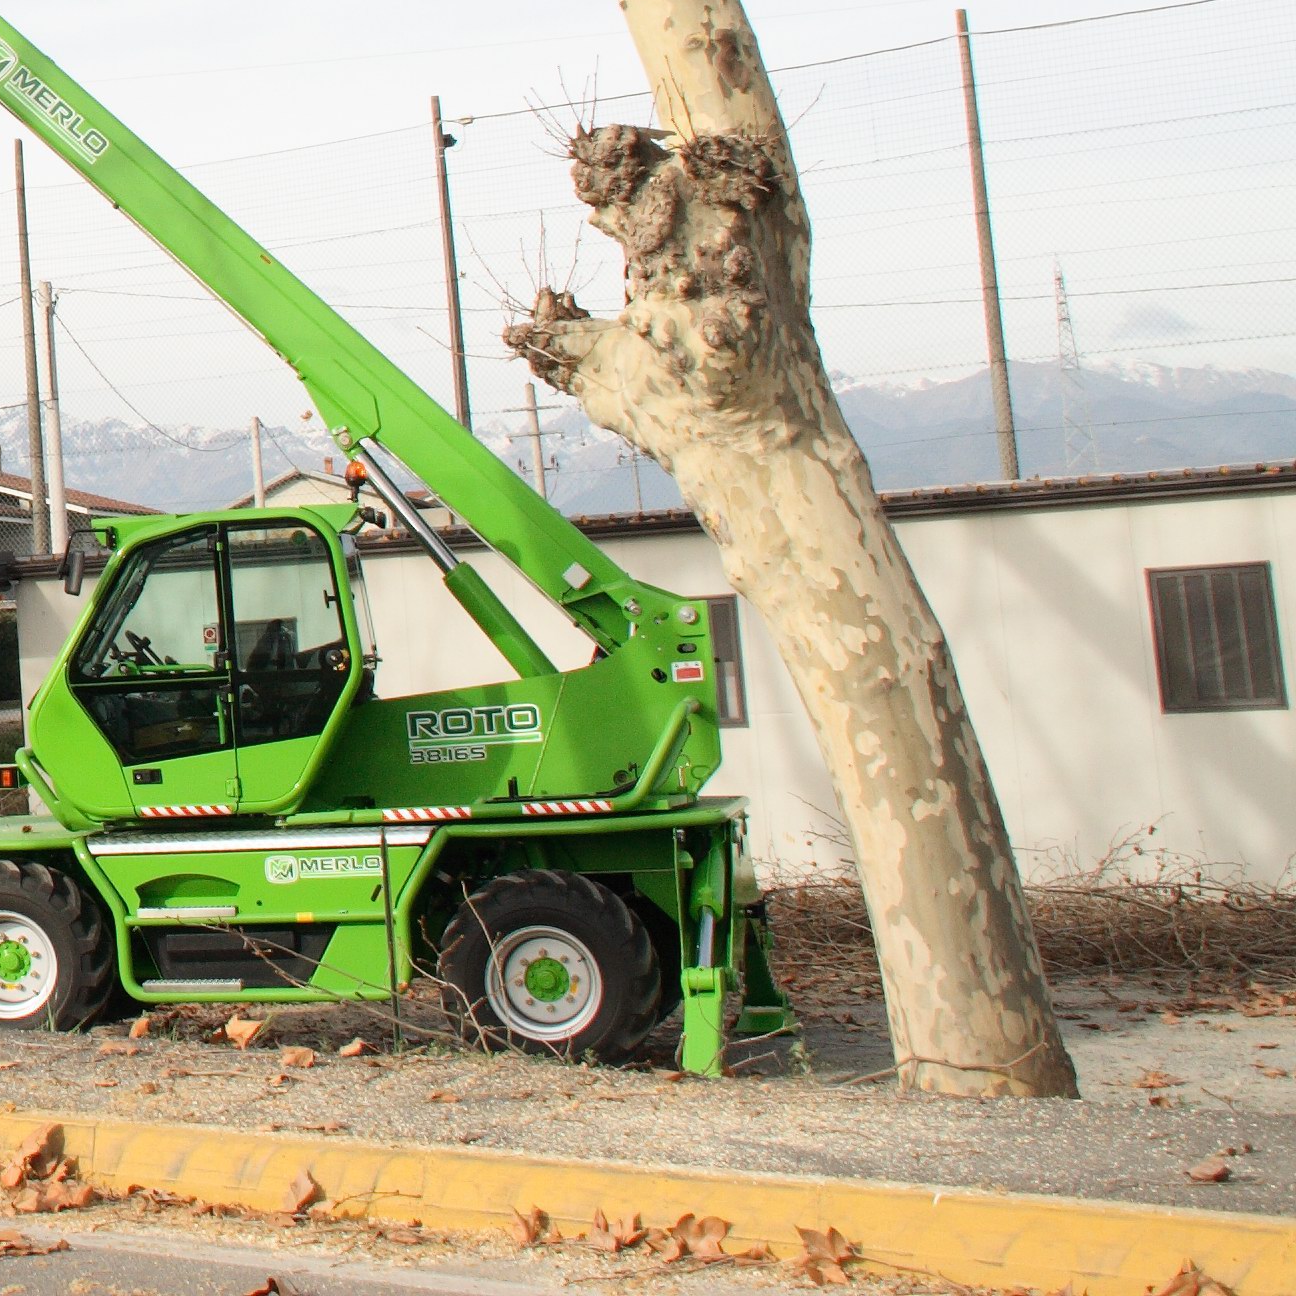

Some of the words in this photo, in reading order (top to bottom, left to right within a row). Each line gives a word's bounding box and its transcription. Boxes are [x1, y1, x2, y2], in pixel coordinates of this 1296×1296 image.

[11, 66, 109, 156] MERLO
[407, 705, 540, 738] ROTO
[299, 856, 381, 872] MERLO
